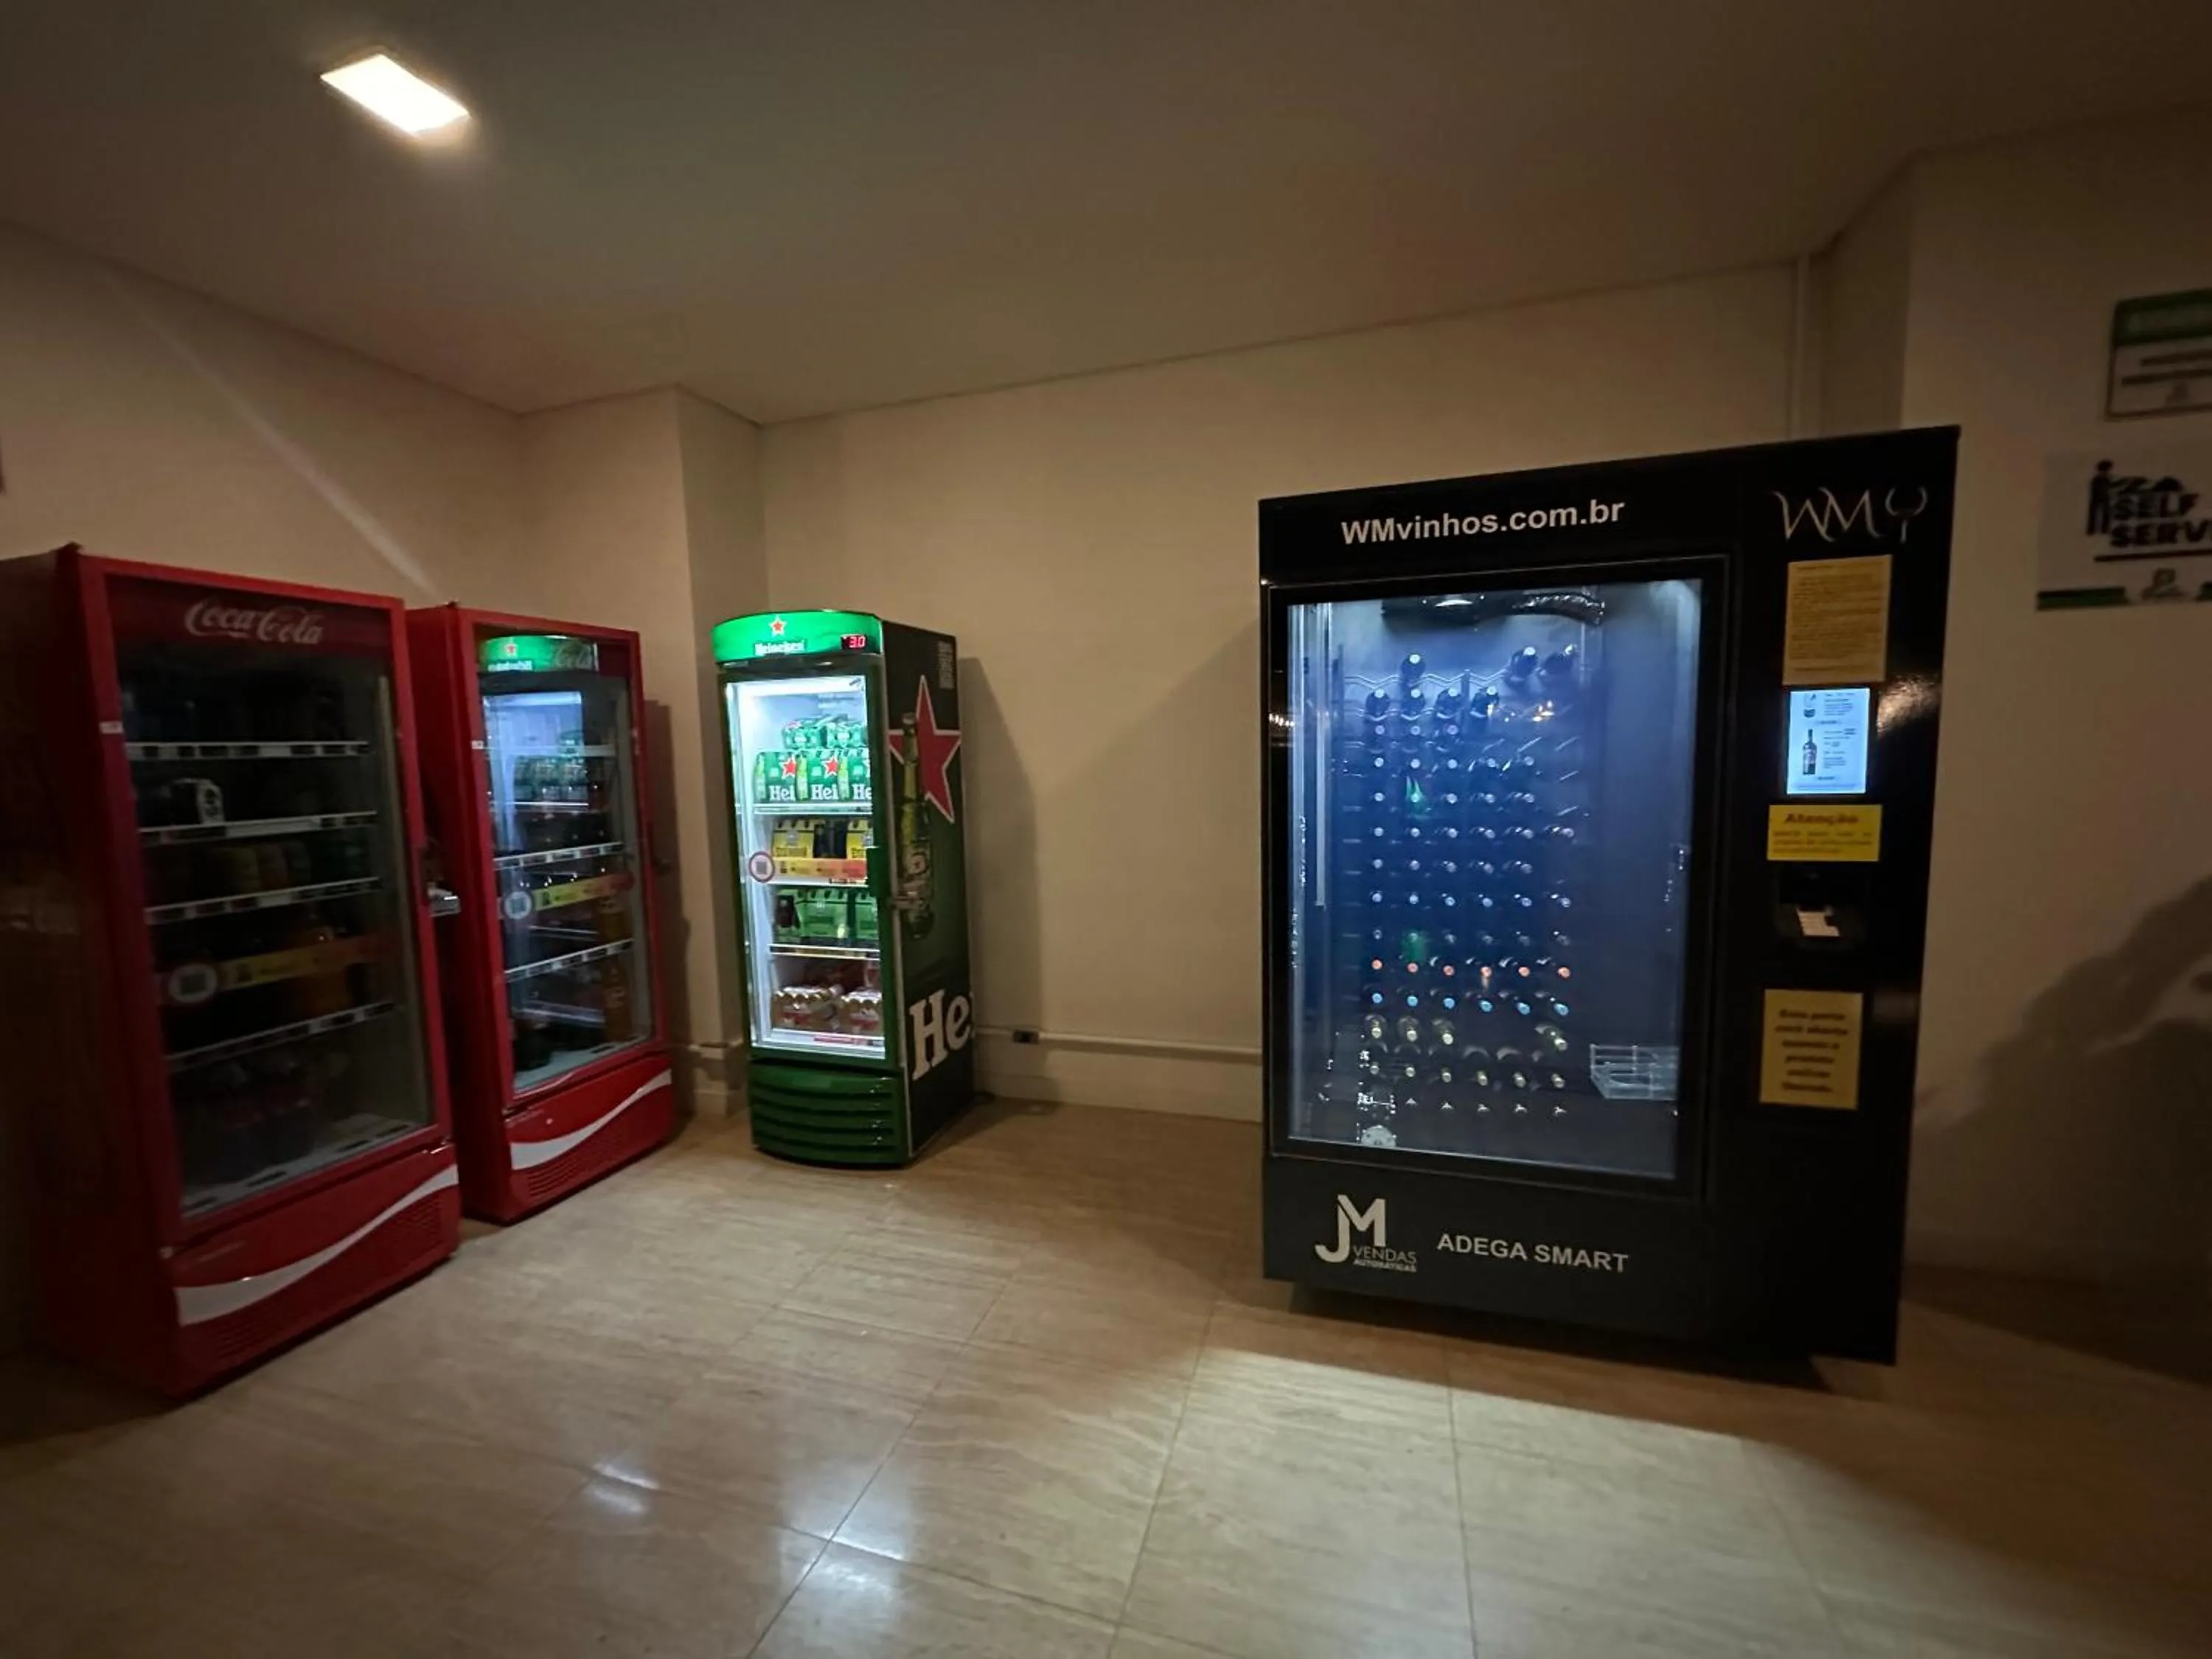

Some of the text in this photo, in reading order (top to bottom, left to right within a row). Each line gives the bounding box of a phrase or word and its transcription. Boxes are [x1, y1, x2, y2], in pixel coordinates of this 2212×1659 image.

[1340, 498, 1625, 545] WMvinhos.com.br
[2110, 519, 2212, 547] SERV
[810, 784, 839, 801] Hei
[1315, 1194, 1386, 1263] JM
[1352, 1244, 1417, 1265] VENDAS
[1436, 1233, 1630, 1273] ADEGA SMART
